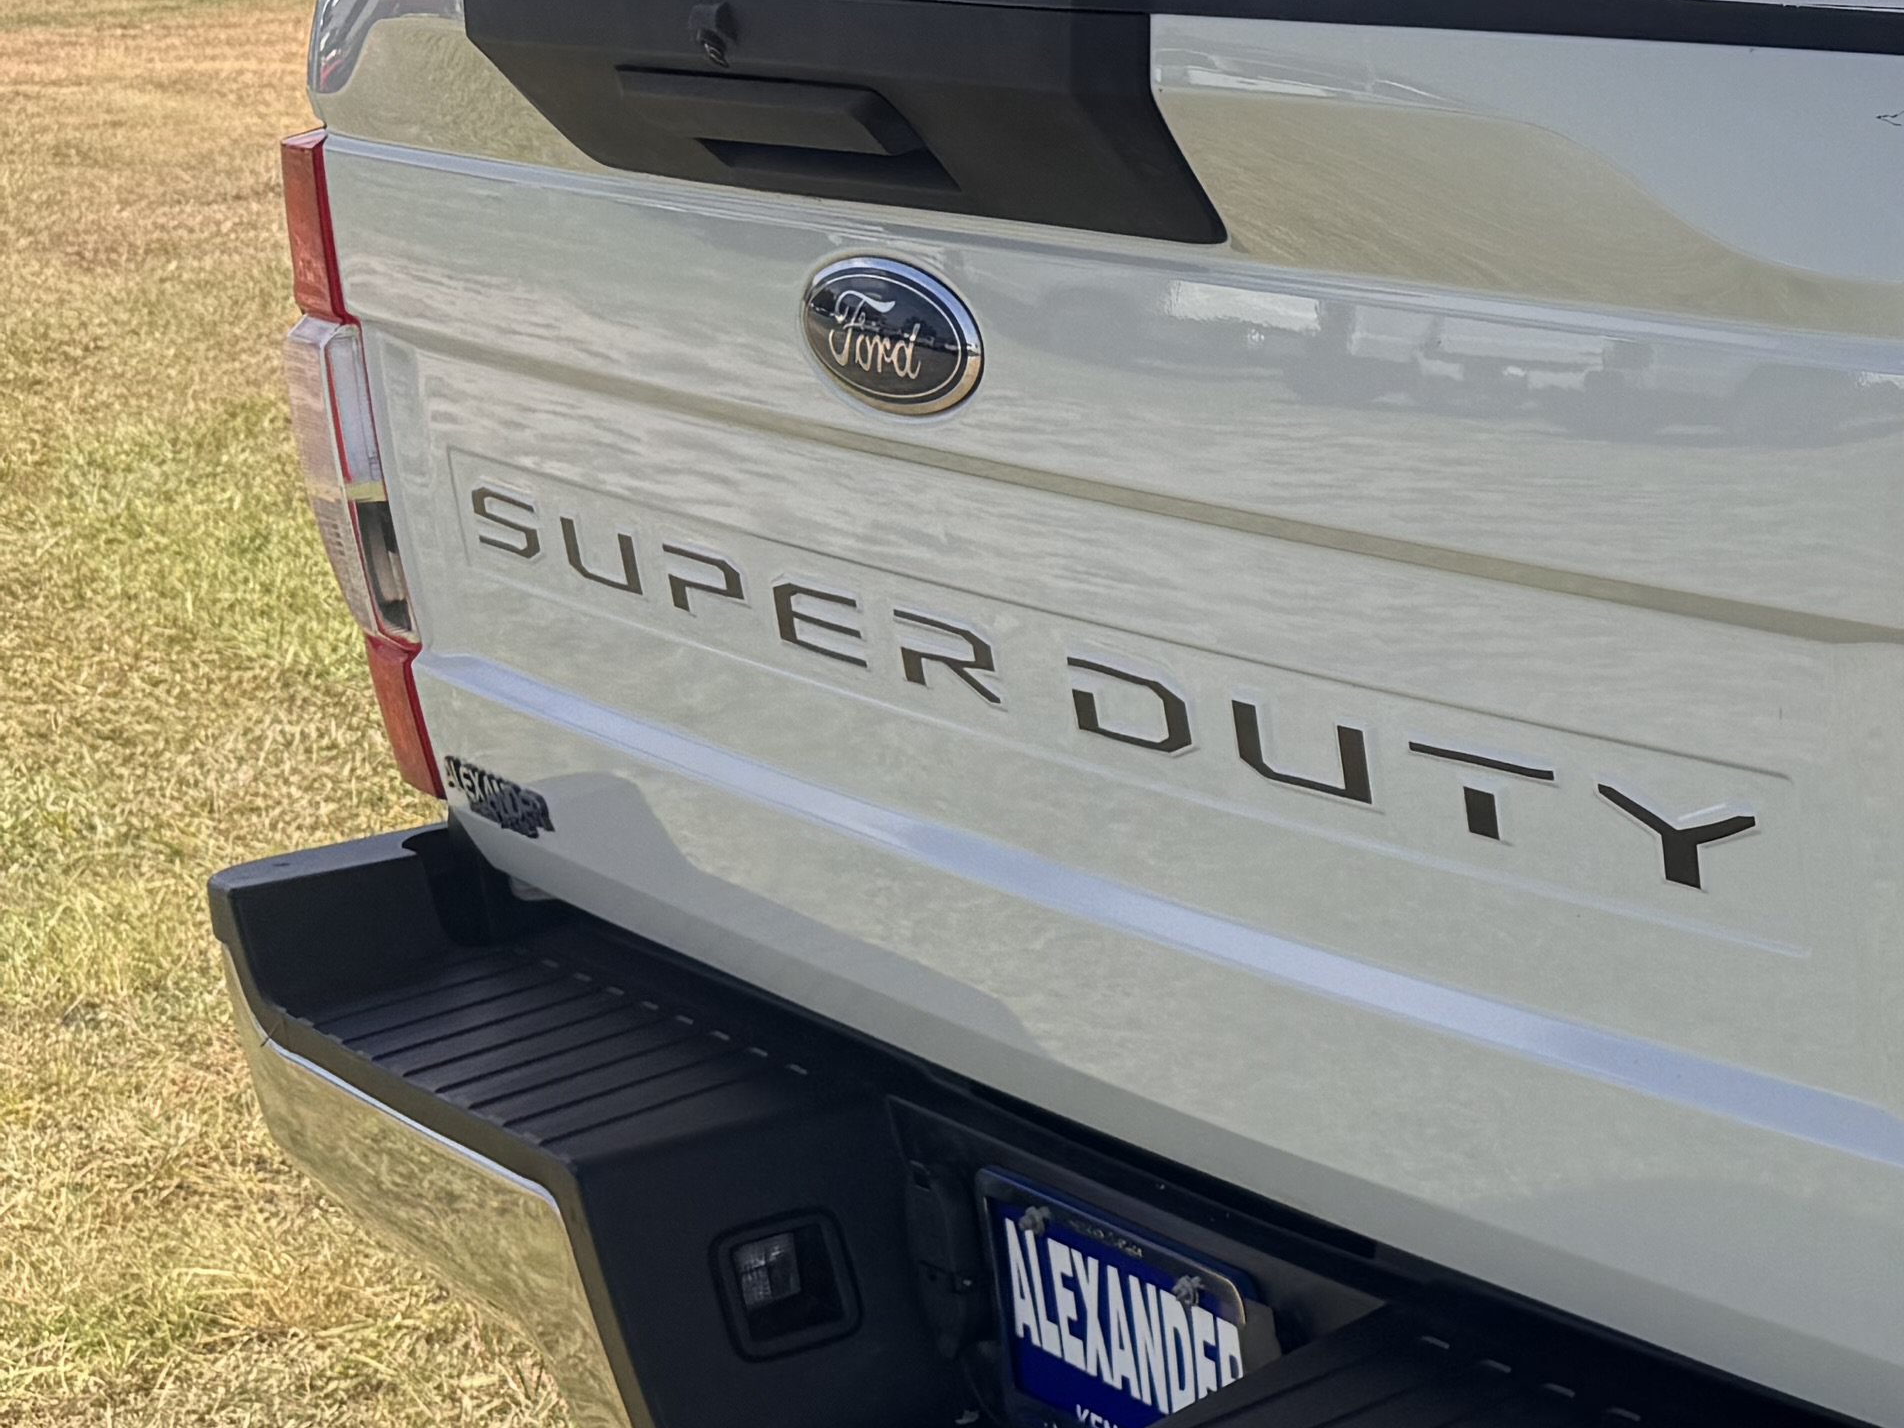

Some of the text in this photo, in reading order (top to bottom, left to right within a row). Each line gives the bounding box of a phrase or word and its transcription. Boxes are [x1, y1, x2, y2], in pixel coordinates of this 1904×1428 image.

[828, 290, 921, 380] Ford
[472, 486, 1756, 889] SUPER DUTY
